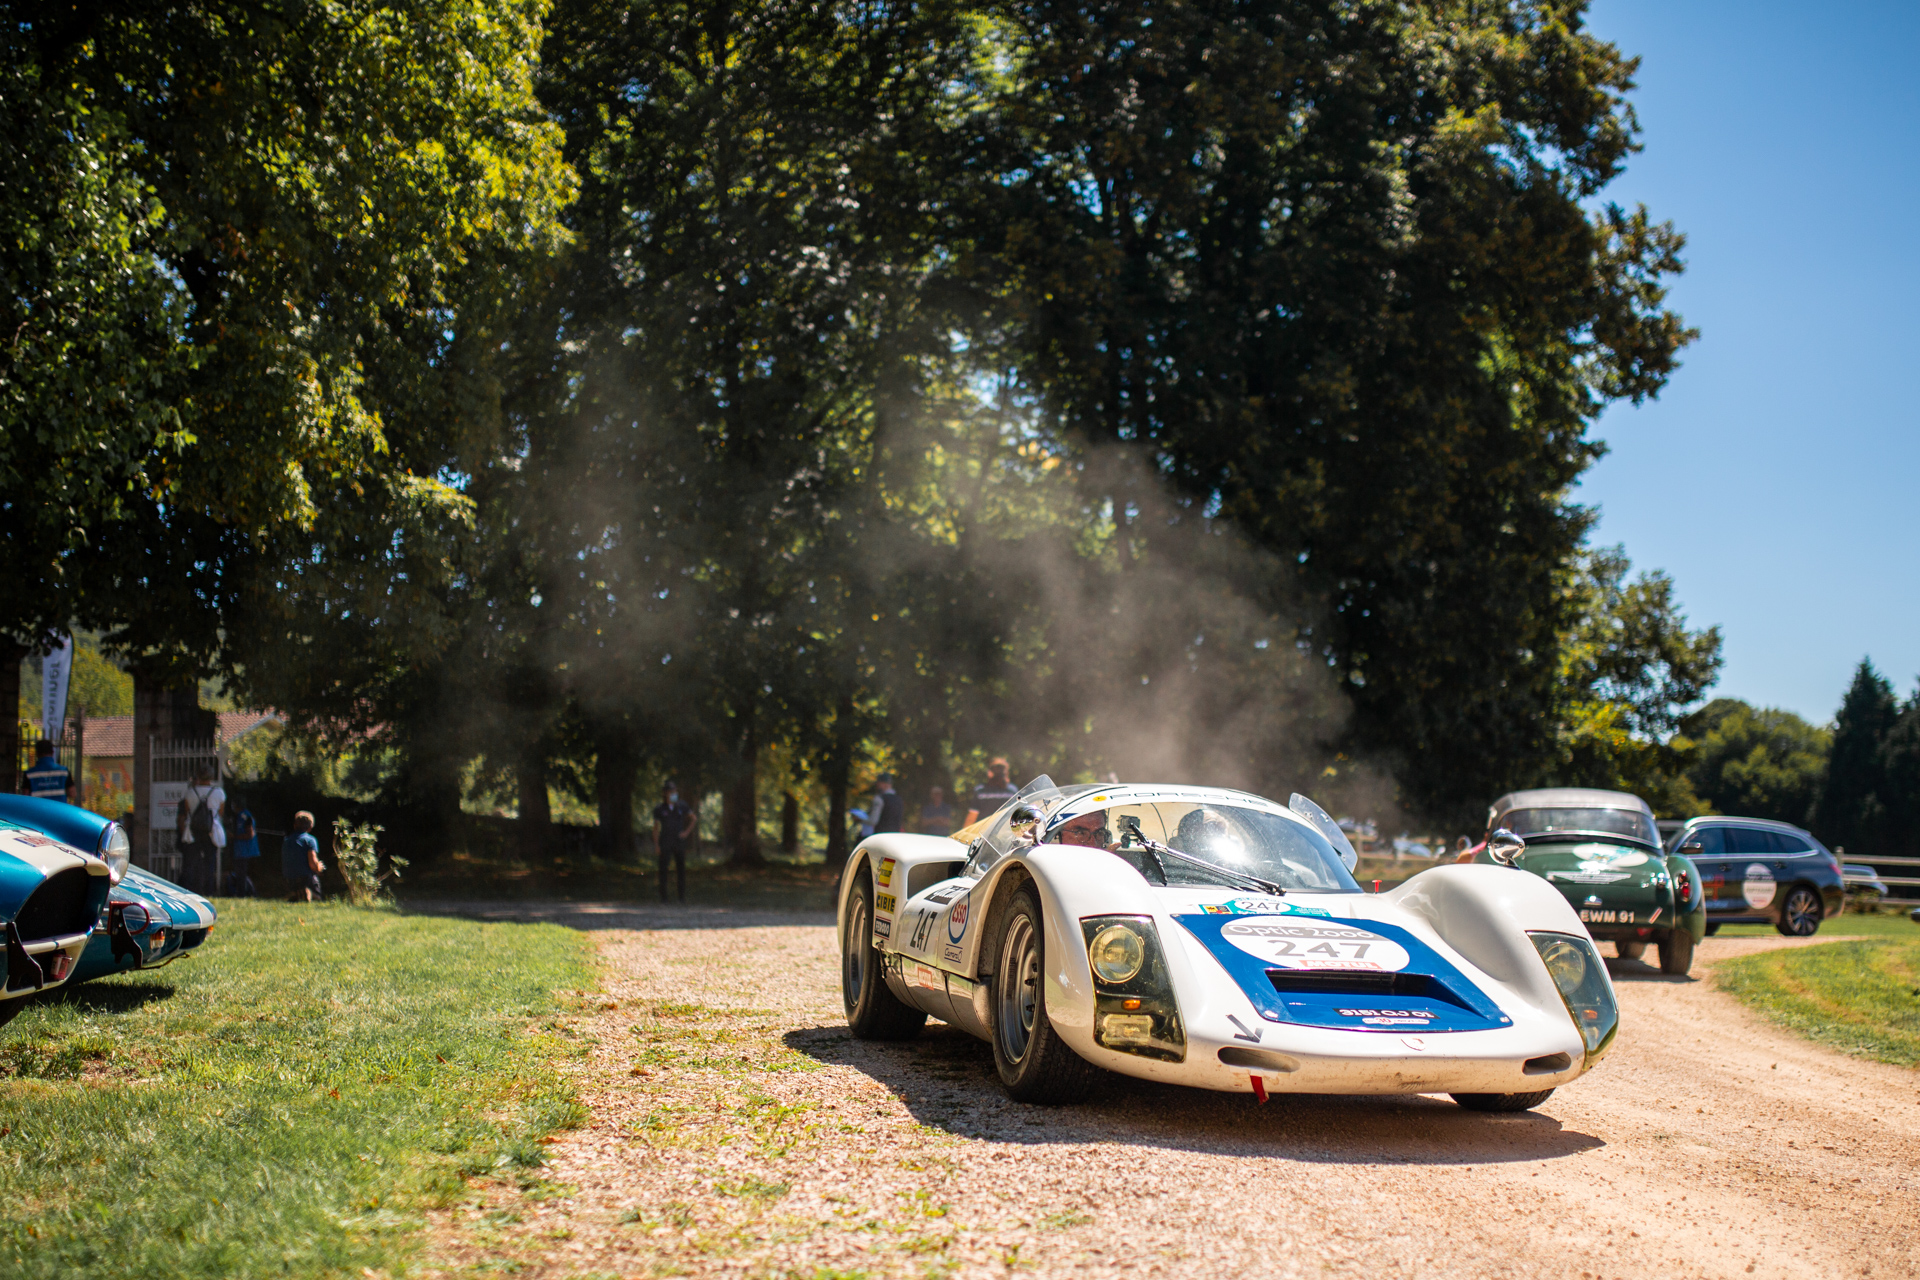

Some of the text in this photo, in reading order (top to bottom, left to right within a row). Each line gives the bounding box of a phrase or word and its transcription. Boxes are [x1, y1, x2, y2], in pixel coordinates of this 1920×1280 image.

[1241, 901, 1280, 911] 247
[1580, 910, 1635, 923] EWM 91
[910, 907, 938, 952] 247
[1228, 924, 1375, 939] Optic 2000
[1266, 940, 1371, 959] 247
[1304, 960, 1379, 970] MOTUL
